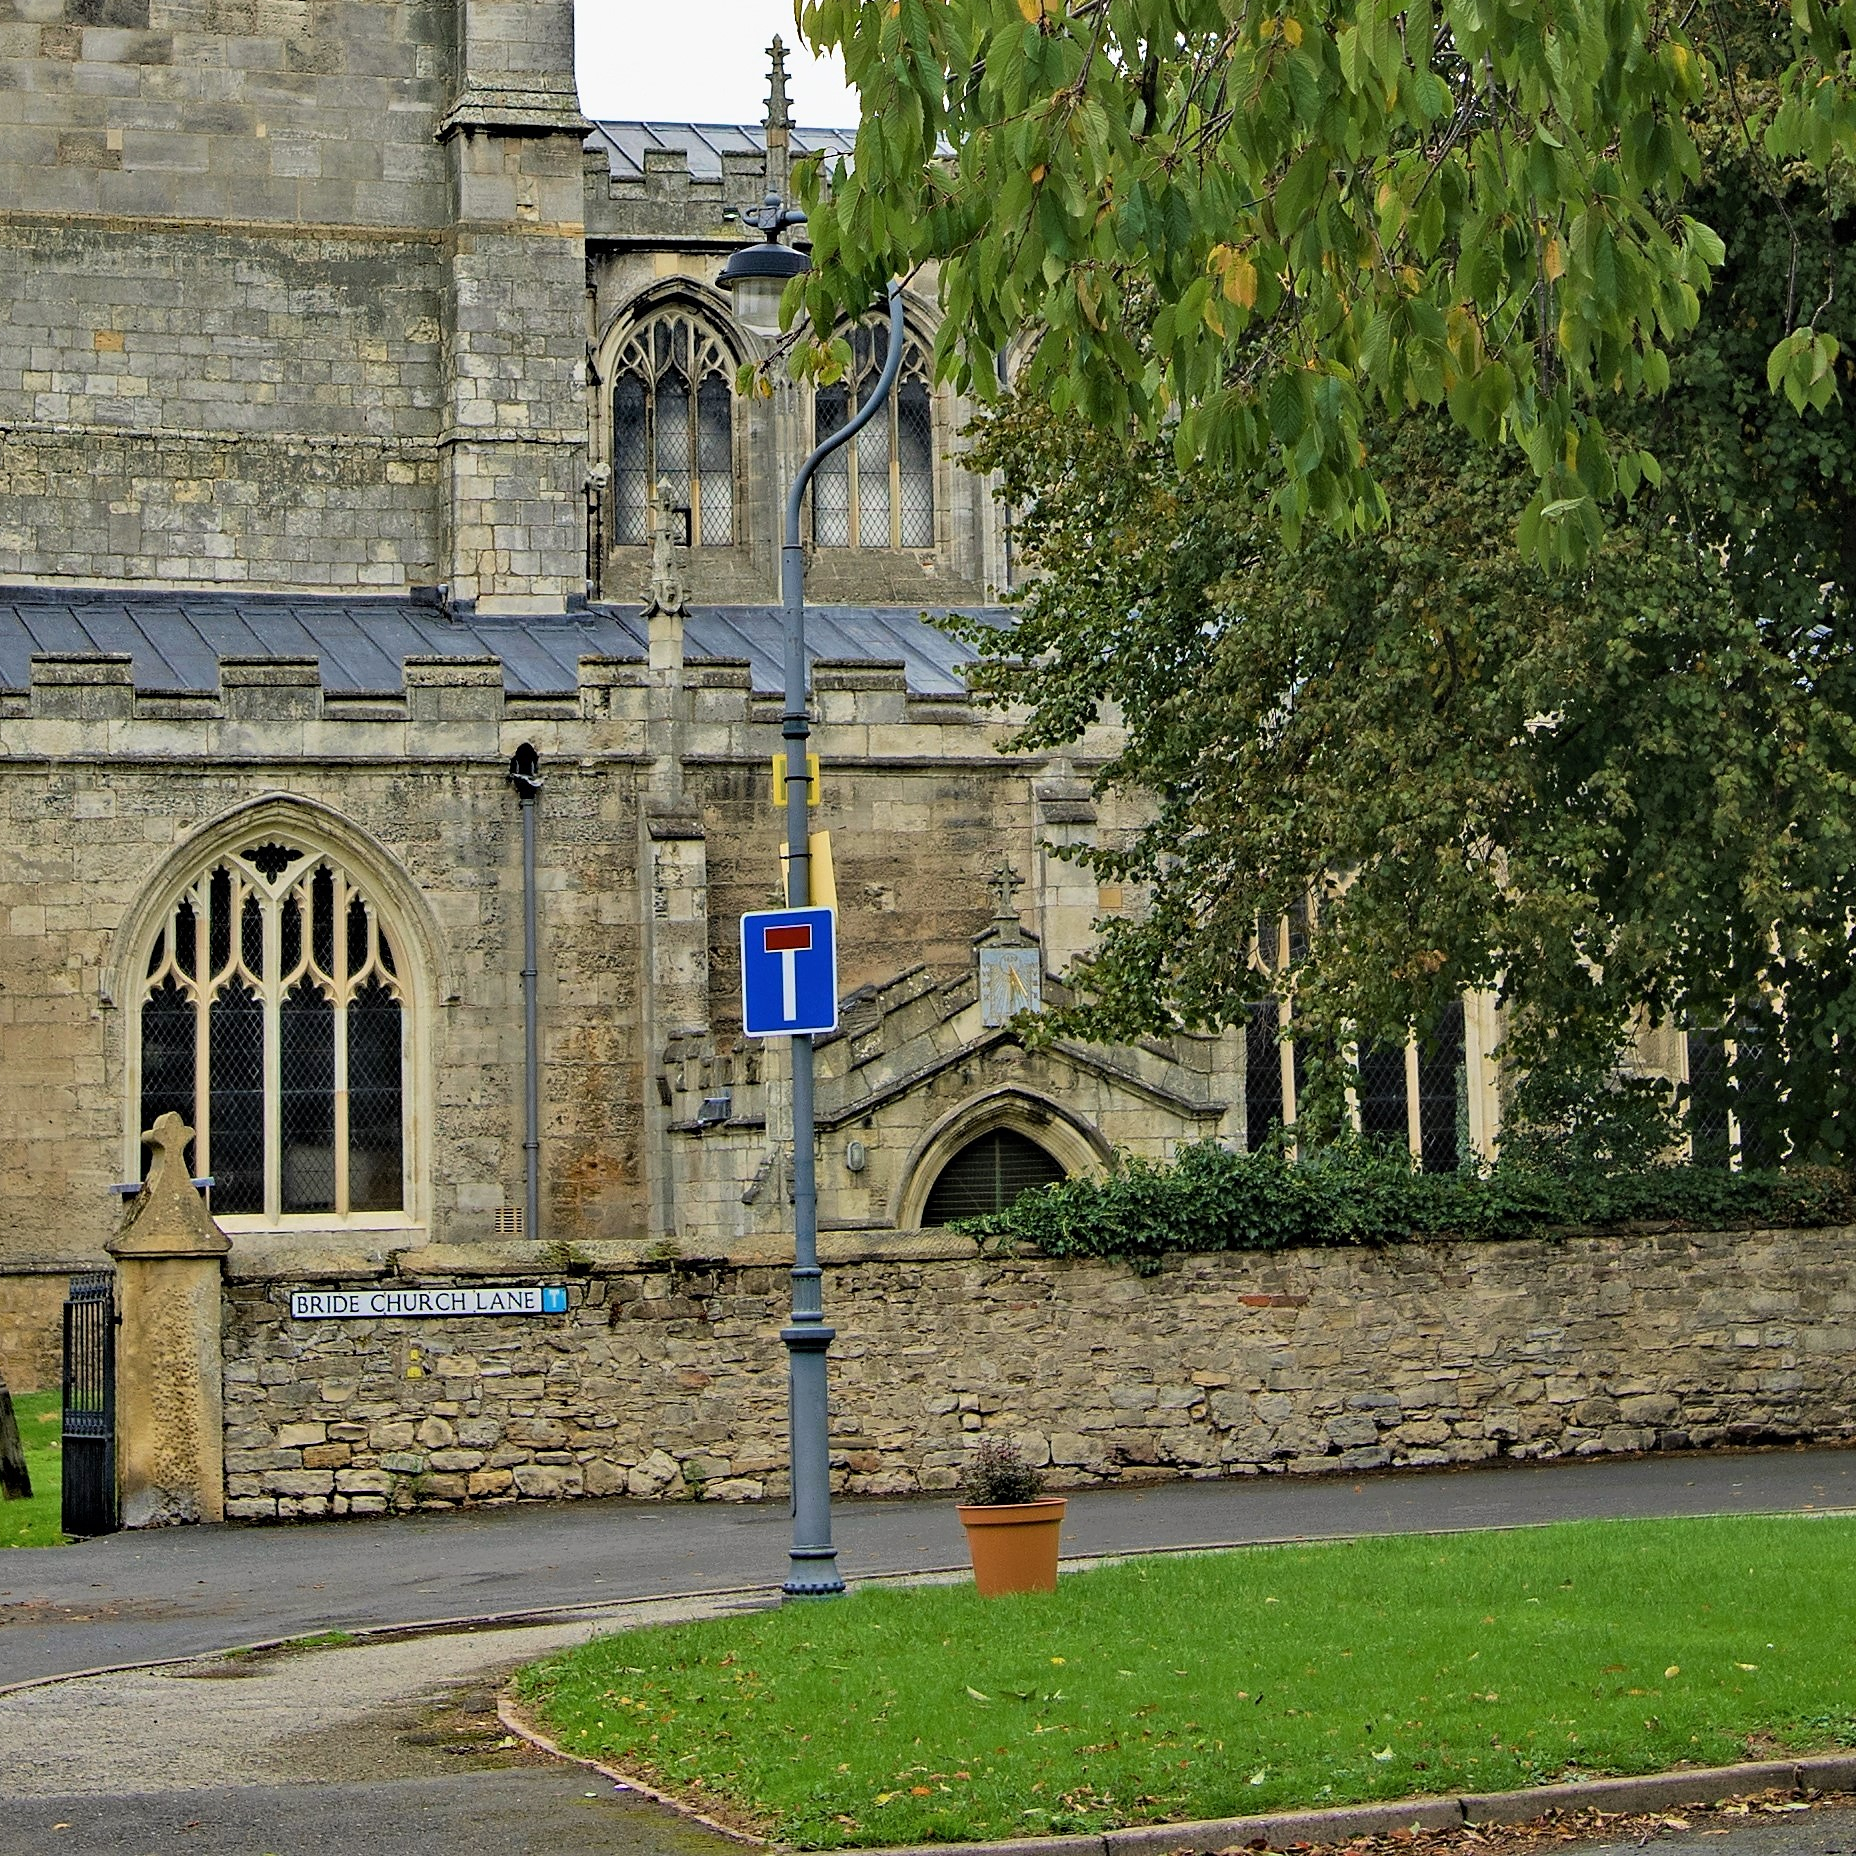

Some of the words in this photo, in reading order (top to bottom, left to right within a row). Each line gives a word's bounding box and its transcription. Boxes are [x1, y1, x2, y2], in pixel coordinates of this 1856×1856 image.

[296, 1293, 360, 1314] BRIDE
[370, 1291, 466, 1313] CHURCH
[476, 1291, 535, 1310] LANE
